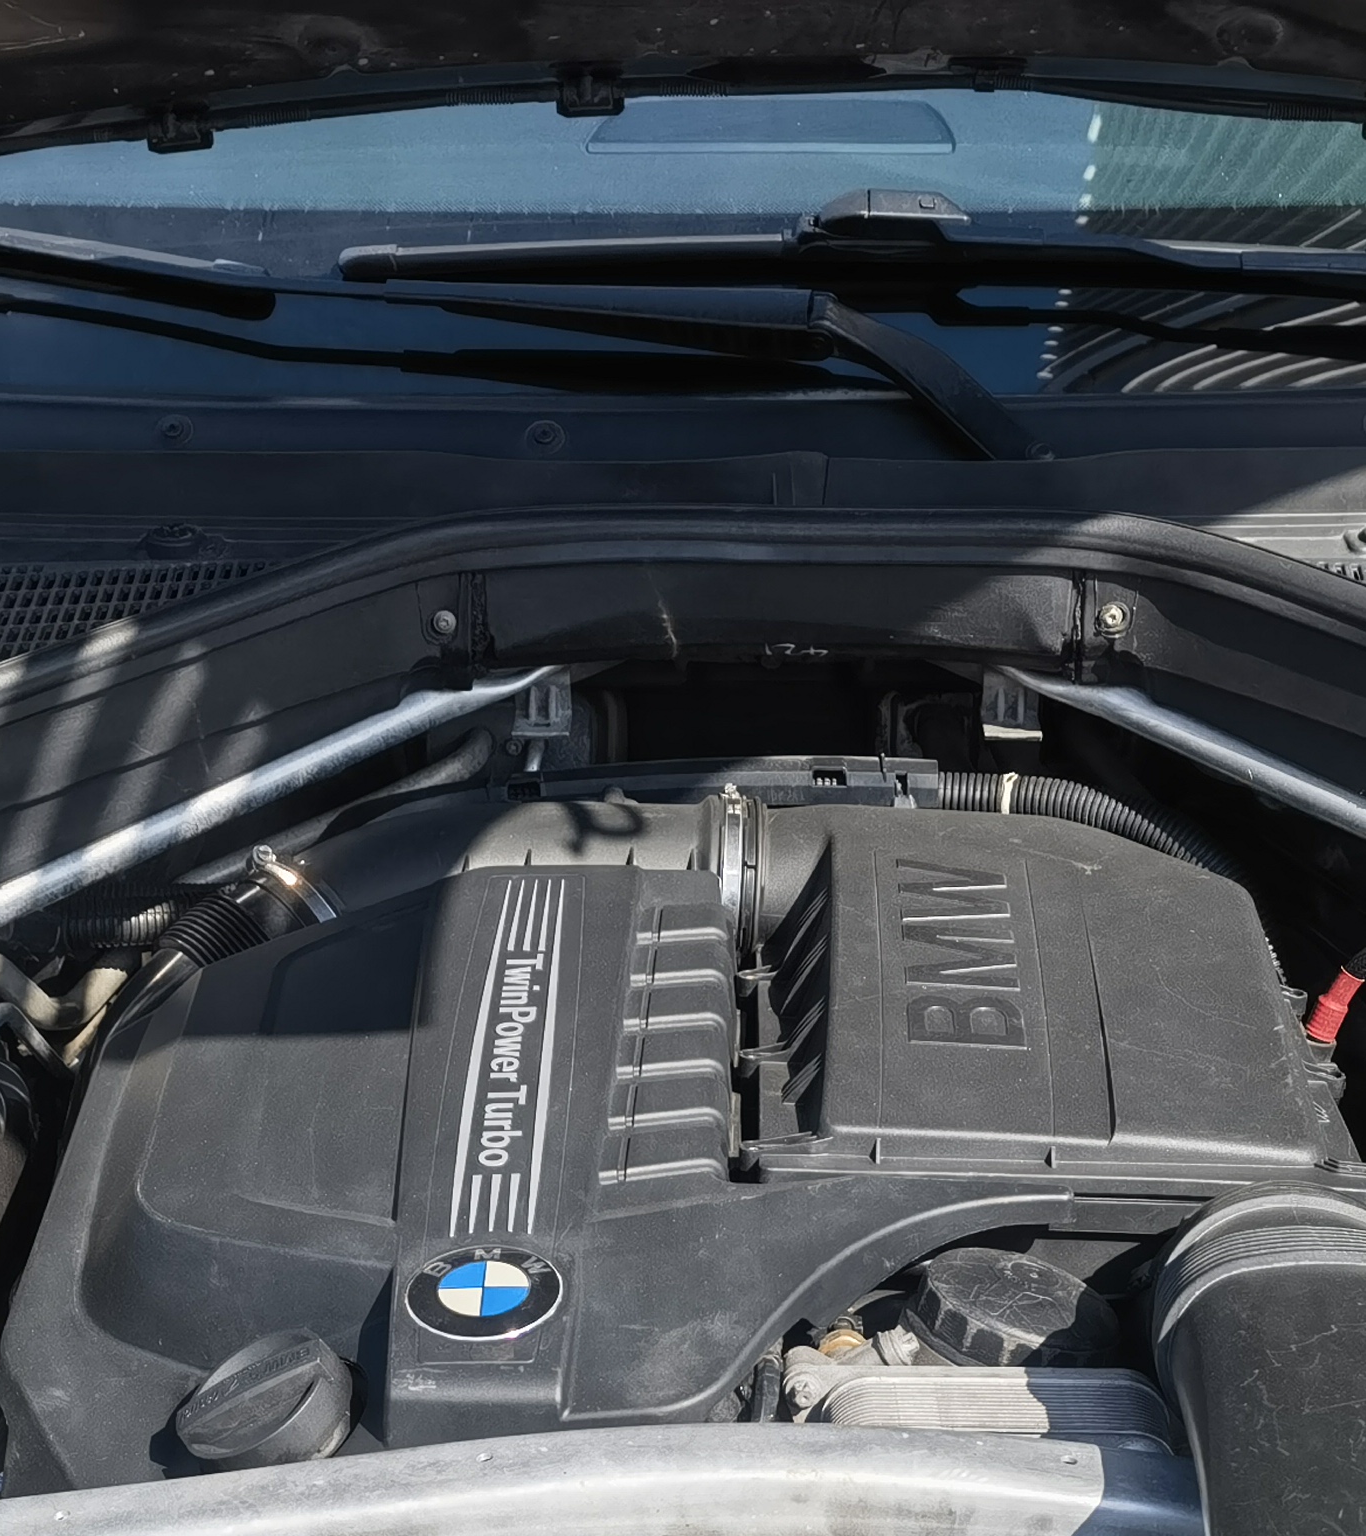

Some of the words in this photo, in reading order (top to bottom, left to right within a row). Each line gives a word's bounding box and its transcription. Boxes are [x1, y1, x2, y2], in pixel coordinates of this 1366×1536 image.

[895, 857, 1028, 1050] BMW
[488, 953, 545, 1083] TwinPower
[477, 1084, 527, 1167] Turbo
[423, 1248, 552, 1278] BMW
